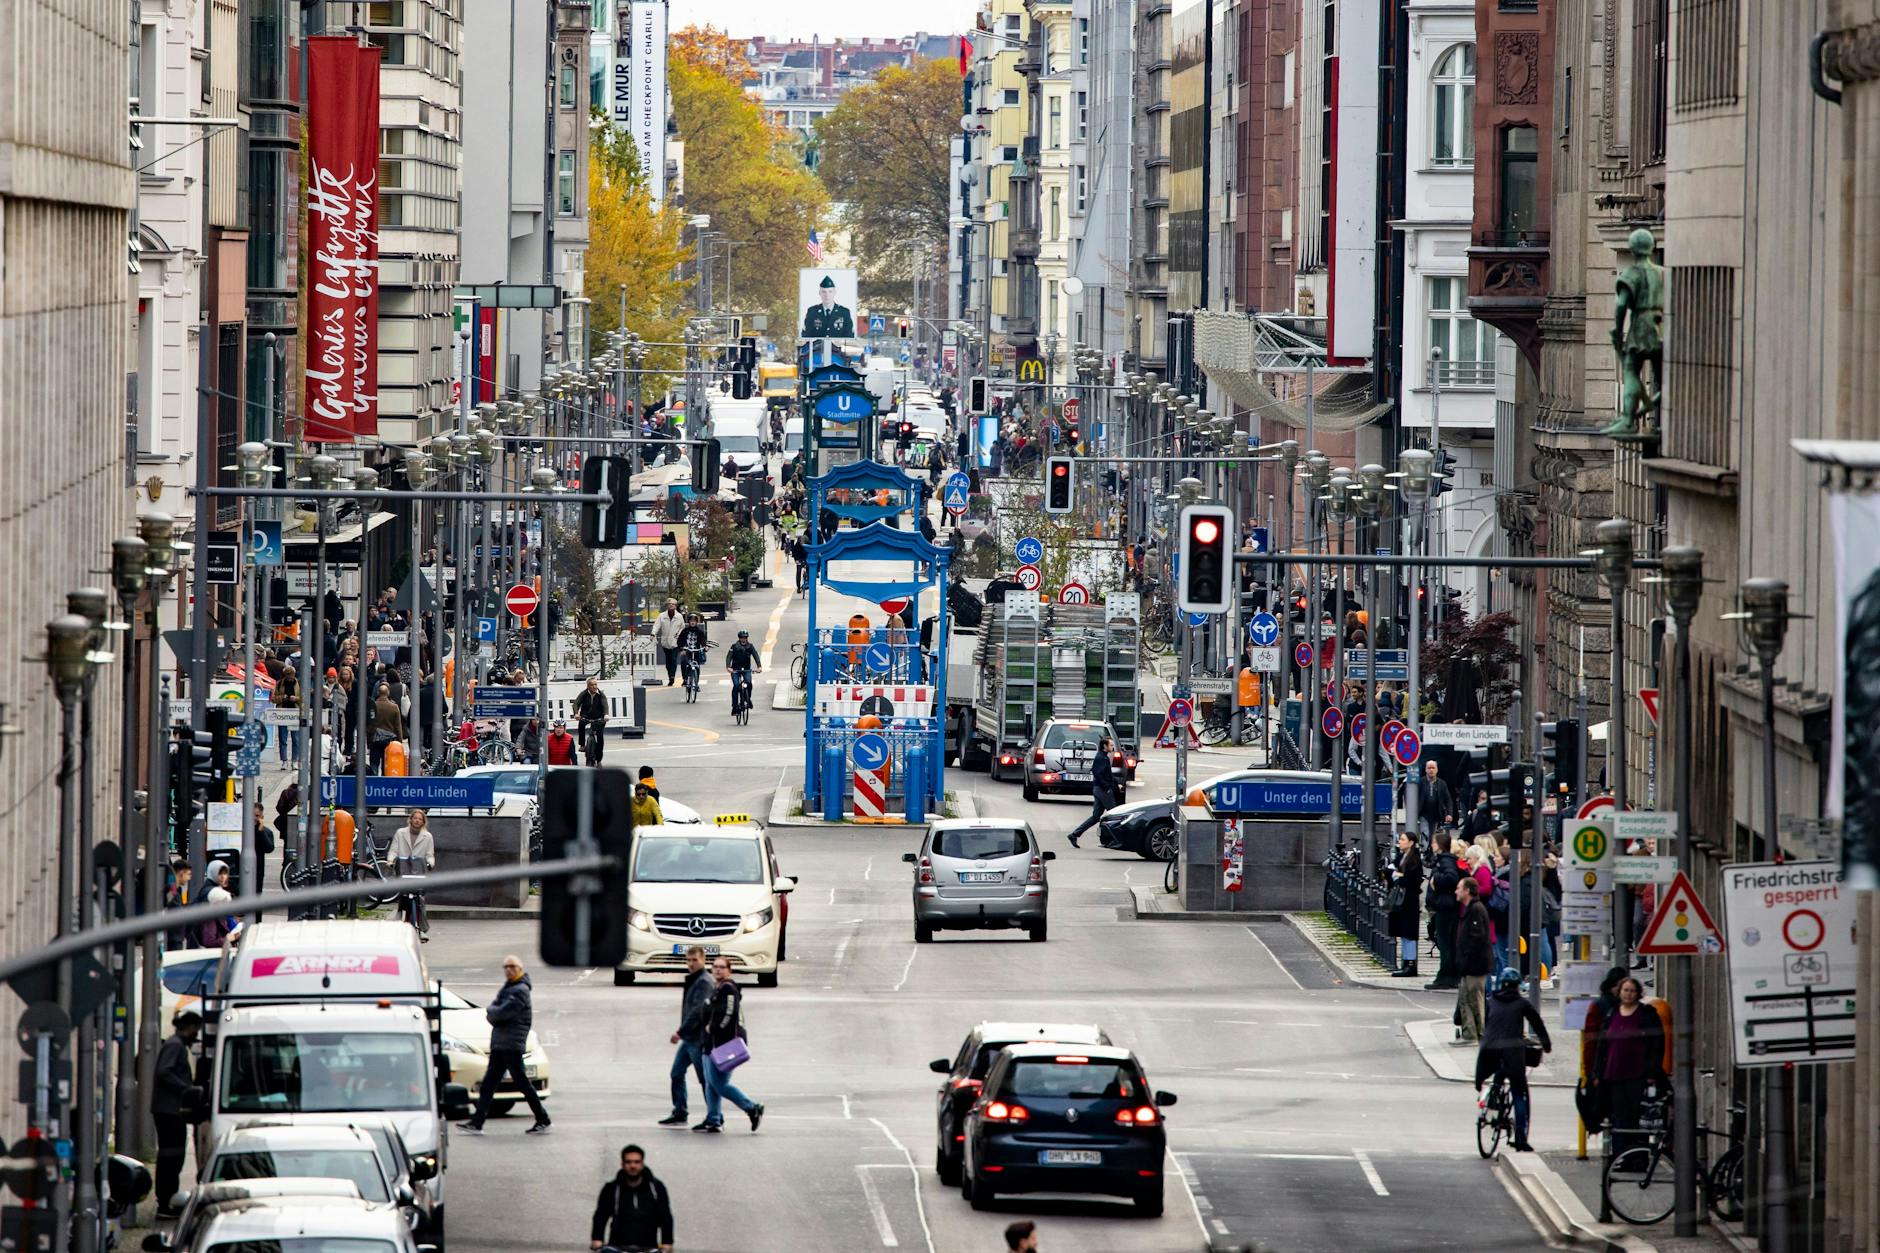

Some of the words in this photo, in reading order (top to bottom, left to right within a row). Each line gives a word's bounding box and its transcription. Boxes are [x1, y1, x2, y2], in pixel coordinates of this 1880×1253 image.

[645, 9, 653, 55] CHARLIE
[615, 64, 630, 101] MUR
[644, 60, 652, 127] CHECKPOINT
[615, 105, 629, 122] LE
[644, 131, 651, 147] AM
[308, 157, 357, 299] Lafayette
[305, 307, 354, 420] Galeries
[1021, 573, 1035, 584] 20
[1065, 591, 1081, 604] 20
[368, 634, 405, 644] ehrenstraße
[1430, 729, 1453, 737] Unter
[1455, 729, 1471, 739] den
[1472, 730, 1500, 739] Linden
[365, 786, 397, 798] Unter
[401, 785, 424, 798] den
[427, 785, 467, 798] Linden
[1264, 791, 1297, 803] Unter
[1301, 792, 1323, 804] den
[1733, 869, 1845, 890] Friedrichstra
[1764, 886, 1839, 908] gesperrt
[273, 955, 379, 975] ARNDT
